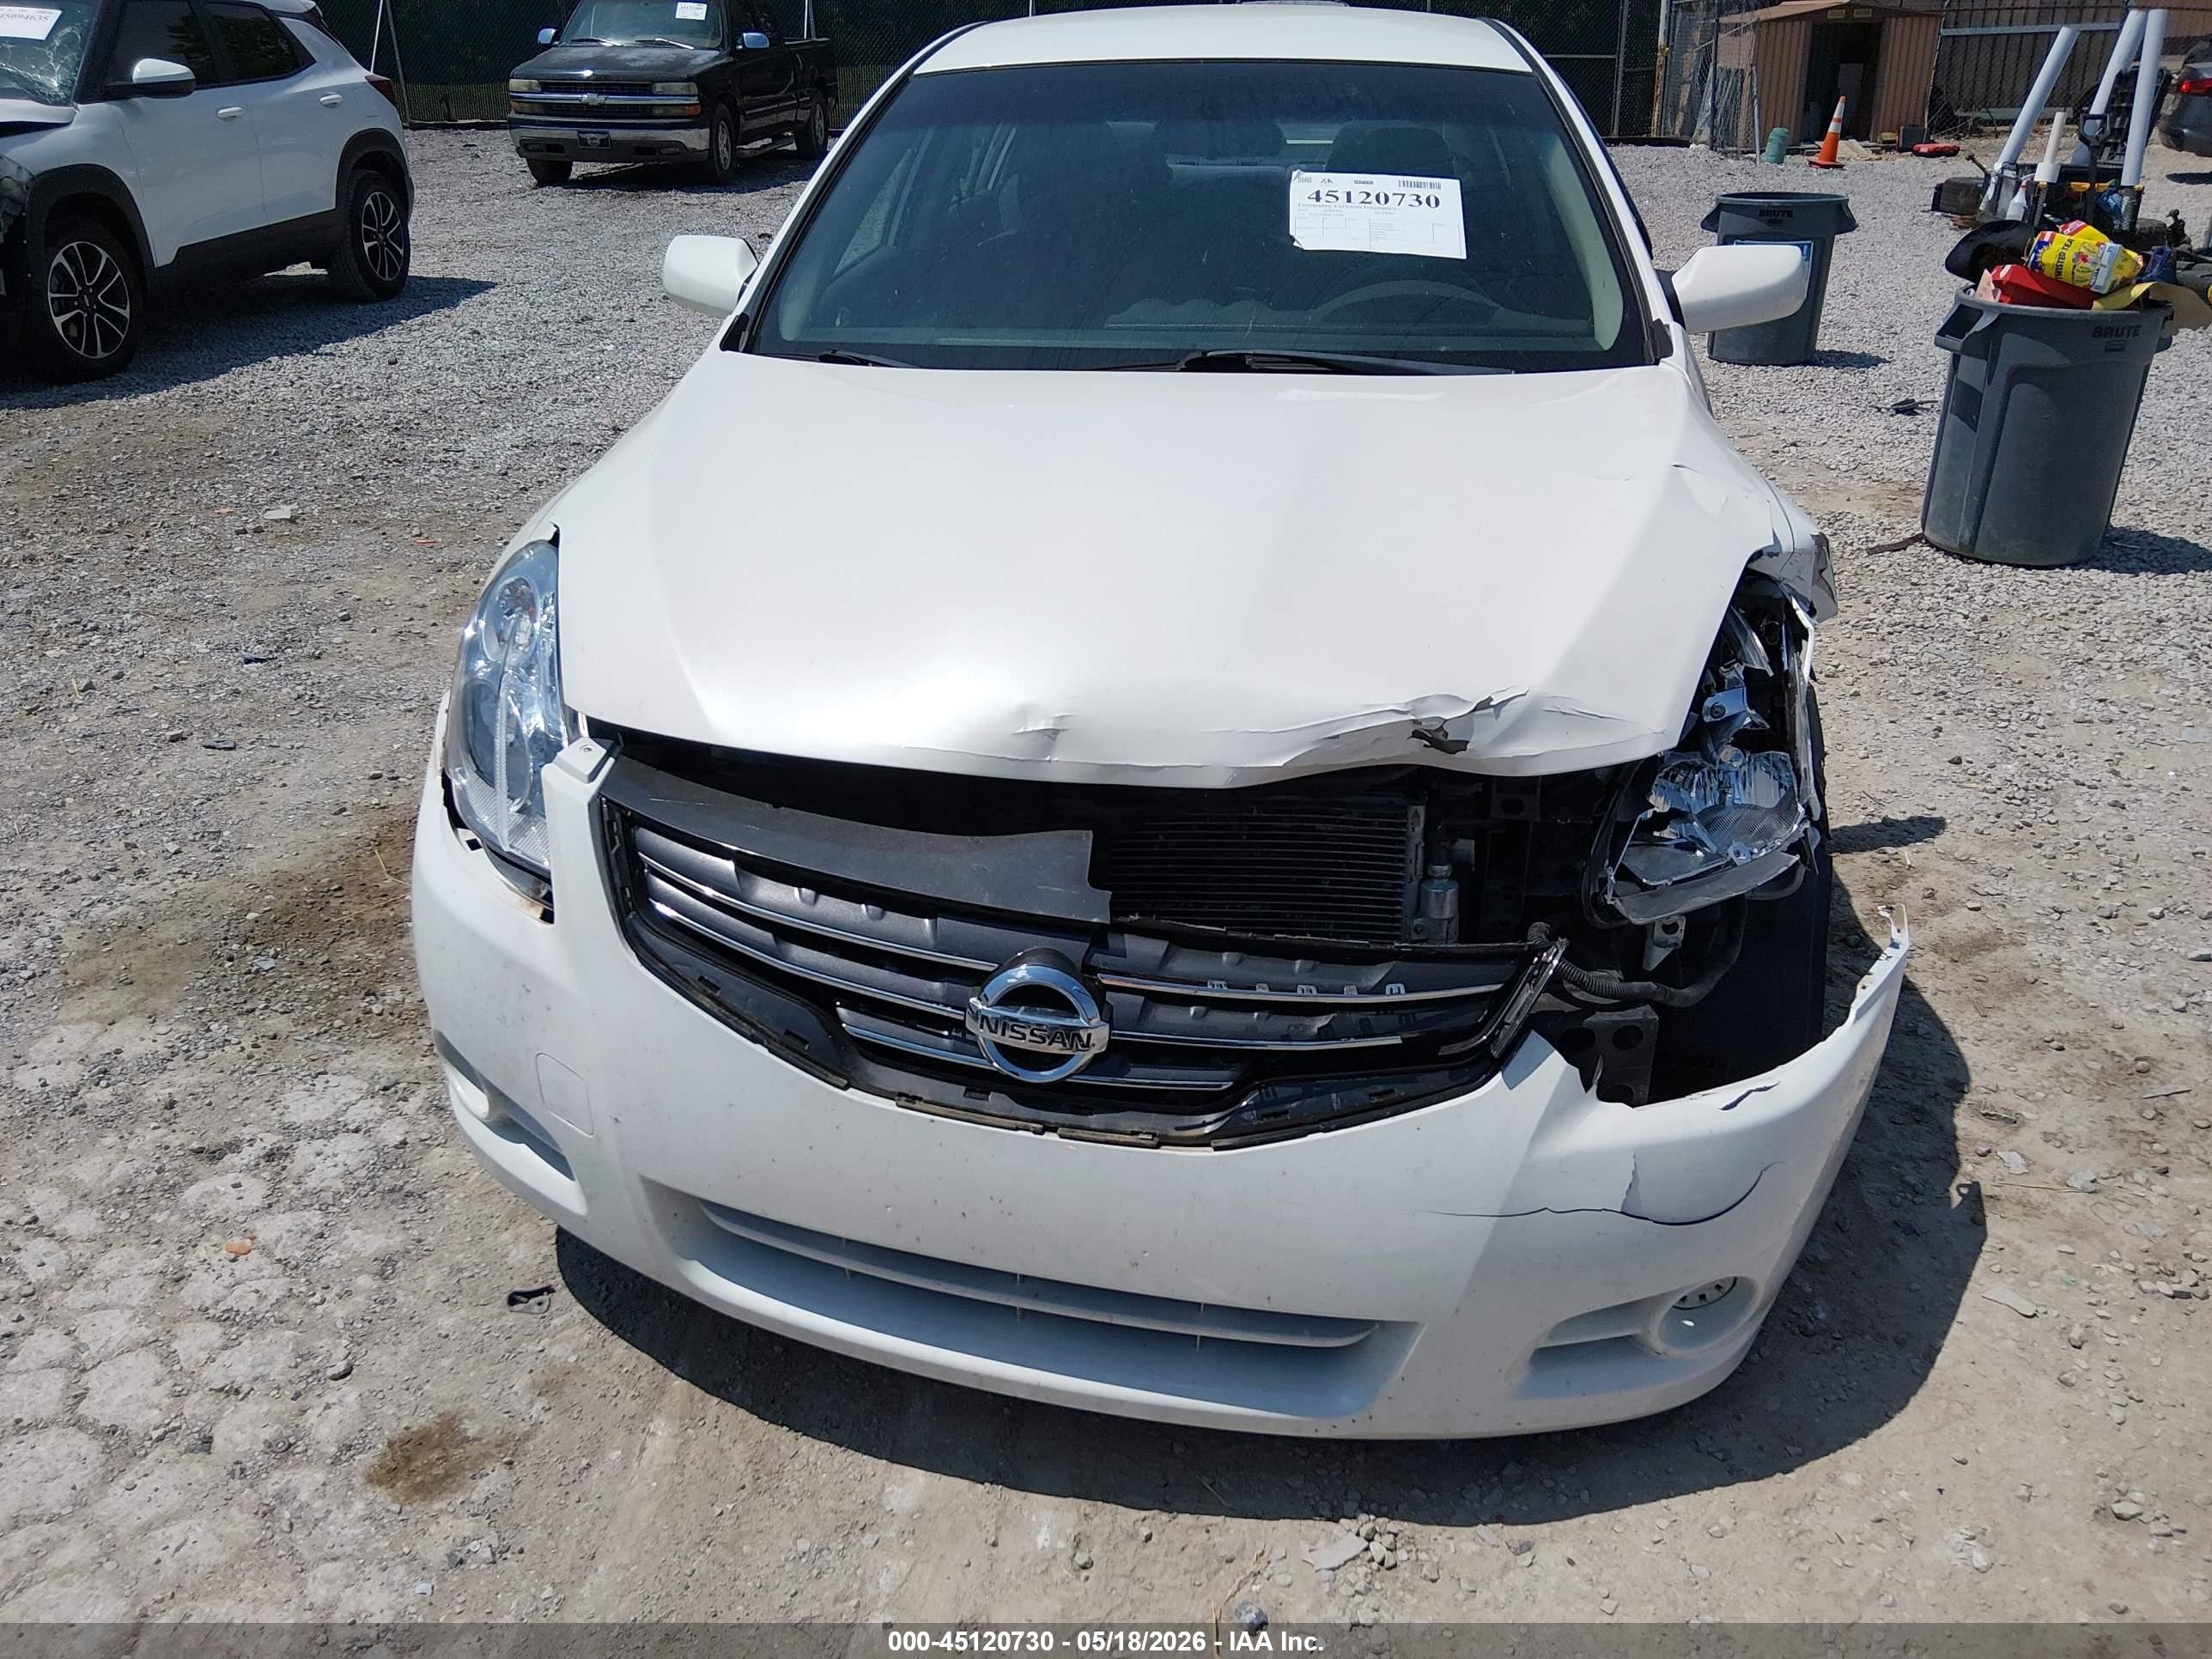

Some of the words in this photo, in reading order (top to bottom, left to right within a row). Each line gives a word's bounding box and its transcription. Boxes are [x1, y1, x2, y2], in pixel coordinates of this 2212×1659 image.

[1307, 189, 1440, 209] 45120730
[1759, 209, 1794, 218] BRUTE
[2054, 252, 2066, 280] TWISTED
[2065, 239, 2075, 252] TEA
[2093, 325, 2142, 338] BRUTE
[980, 1014, 1092, 1052] NISSAN
